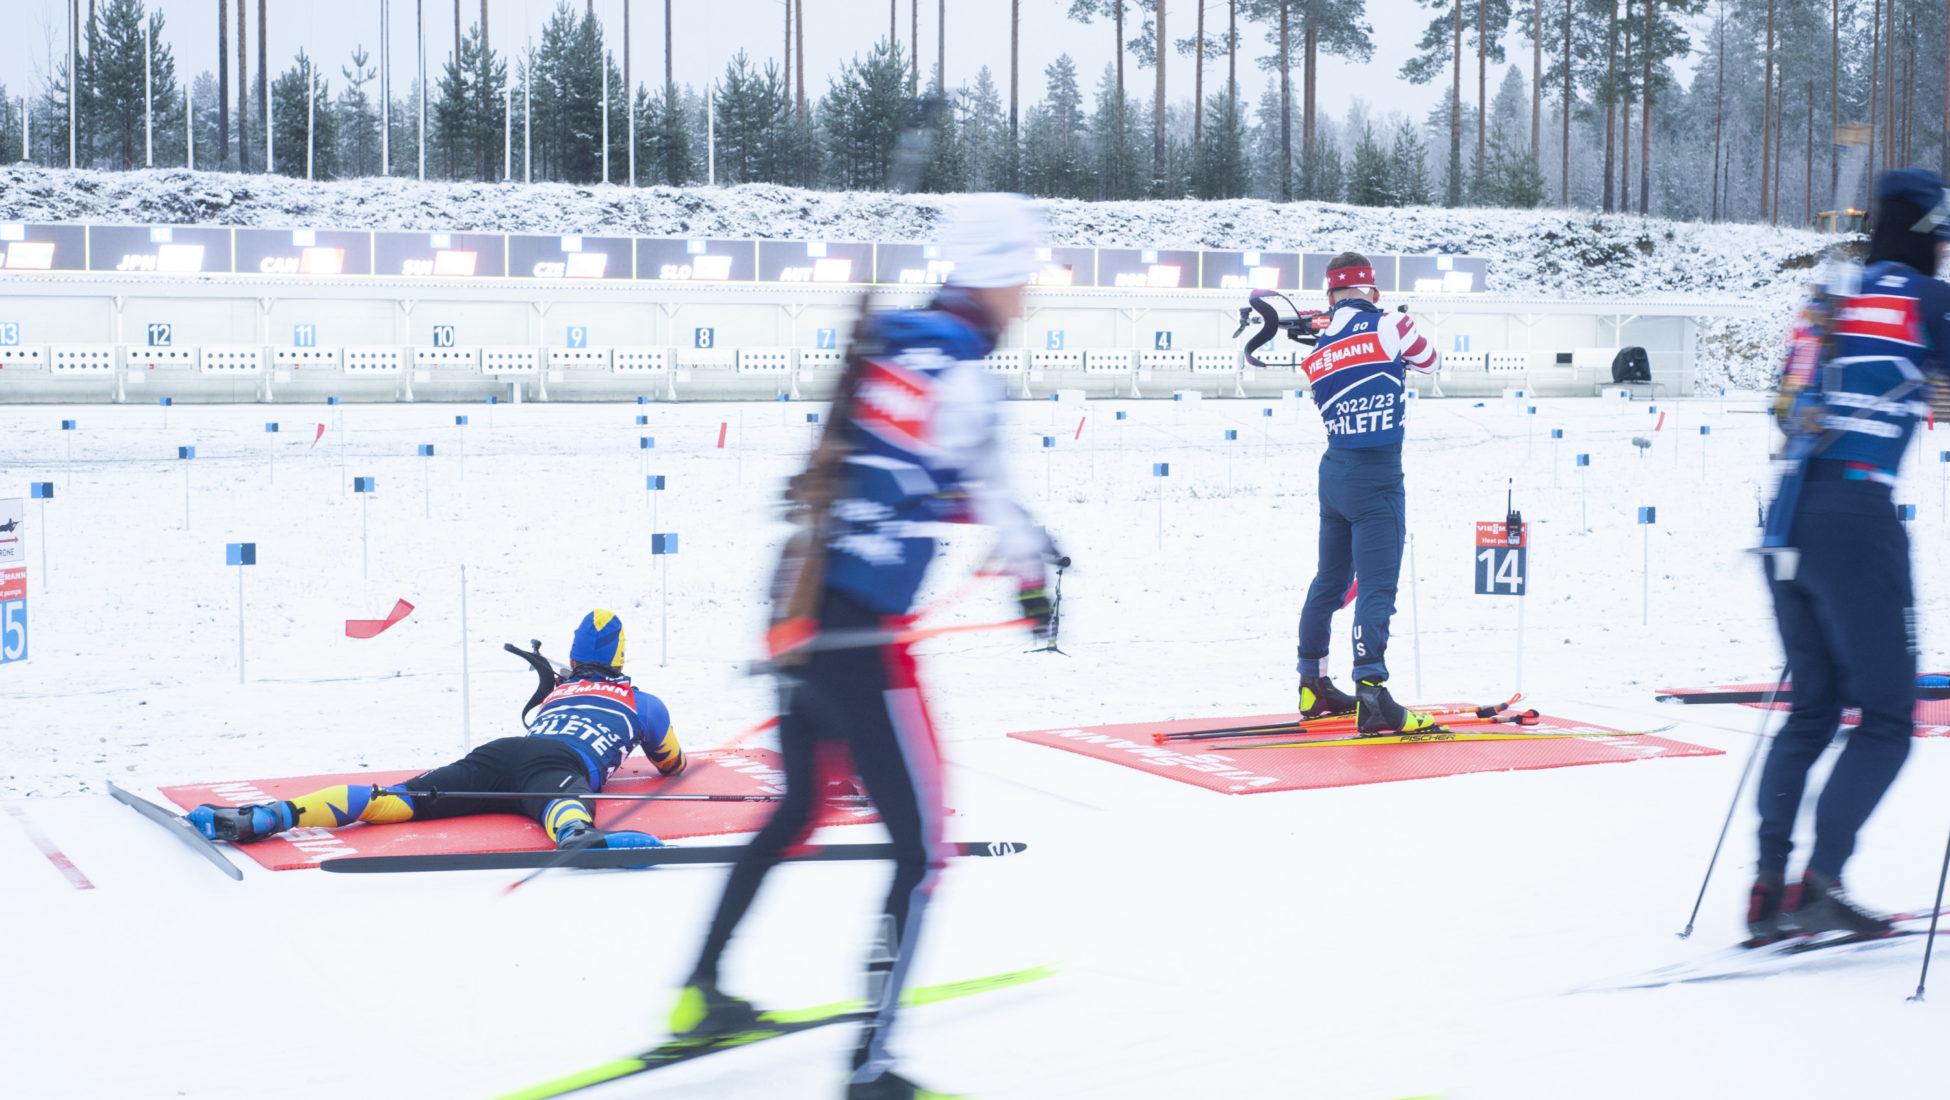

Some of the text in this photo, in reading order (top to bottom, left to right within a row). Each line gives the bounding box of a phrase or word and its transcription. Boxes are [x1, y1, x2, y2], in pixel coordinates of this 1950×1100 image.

[117, 254, 156, 271] JPN
[260, 257, 300, 274] CAN
[659, 264, 692, 280] SLO
[779, 267, 813, 282] AUT
[0, 323, 18, 345] 13
[149, 325, 171, 345] 12
[296, 326, 313, 346] 11
[434, 326, 453, 347] 10
[571, 327, 583, 347] 9
[698, 328, 710, 348] 8
[821, 329, 832, 348] 7
[1050, 330, 1060, 349] 5
[1158, 331, 1168, 350] 4
[1458, 336, 1466, 352] 1
[1307, 342, 1375, 375] VIESSMANN
[1336, 393, 1395, 415] 2022/23
[1477, 548, 1523, 593] 14
[1399, 734, 1457, 743] FISCHER
